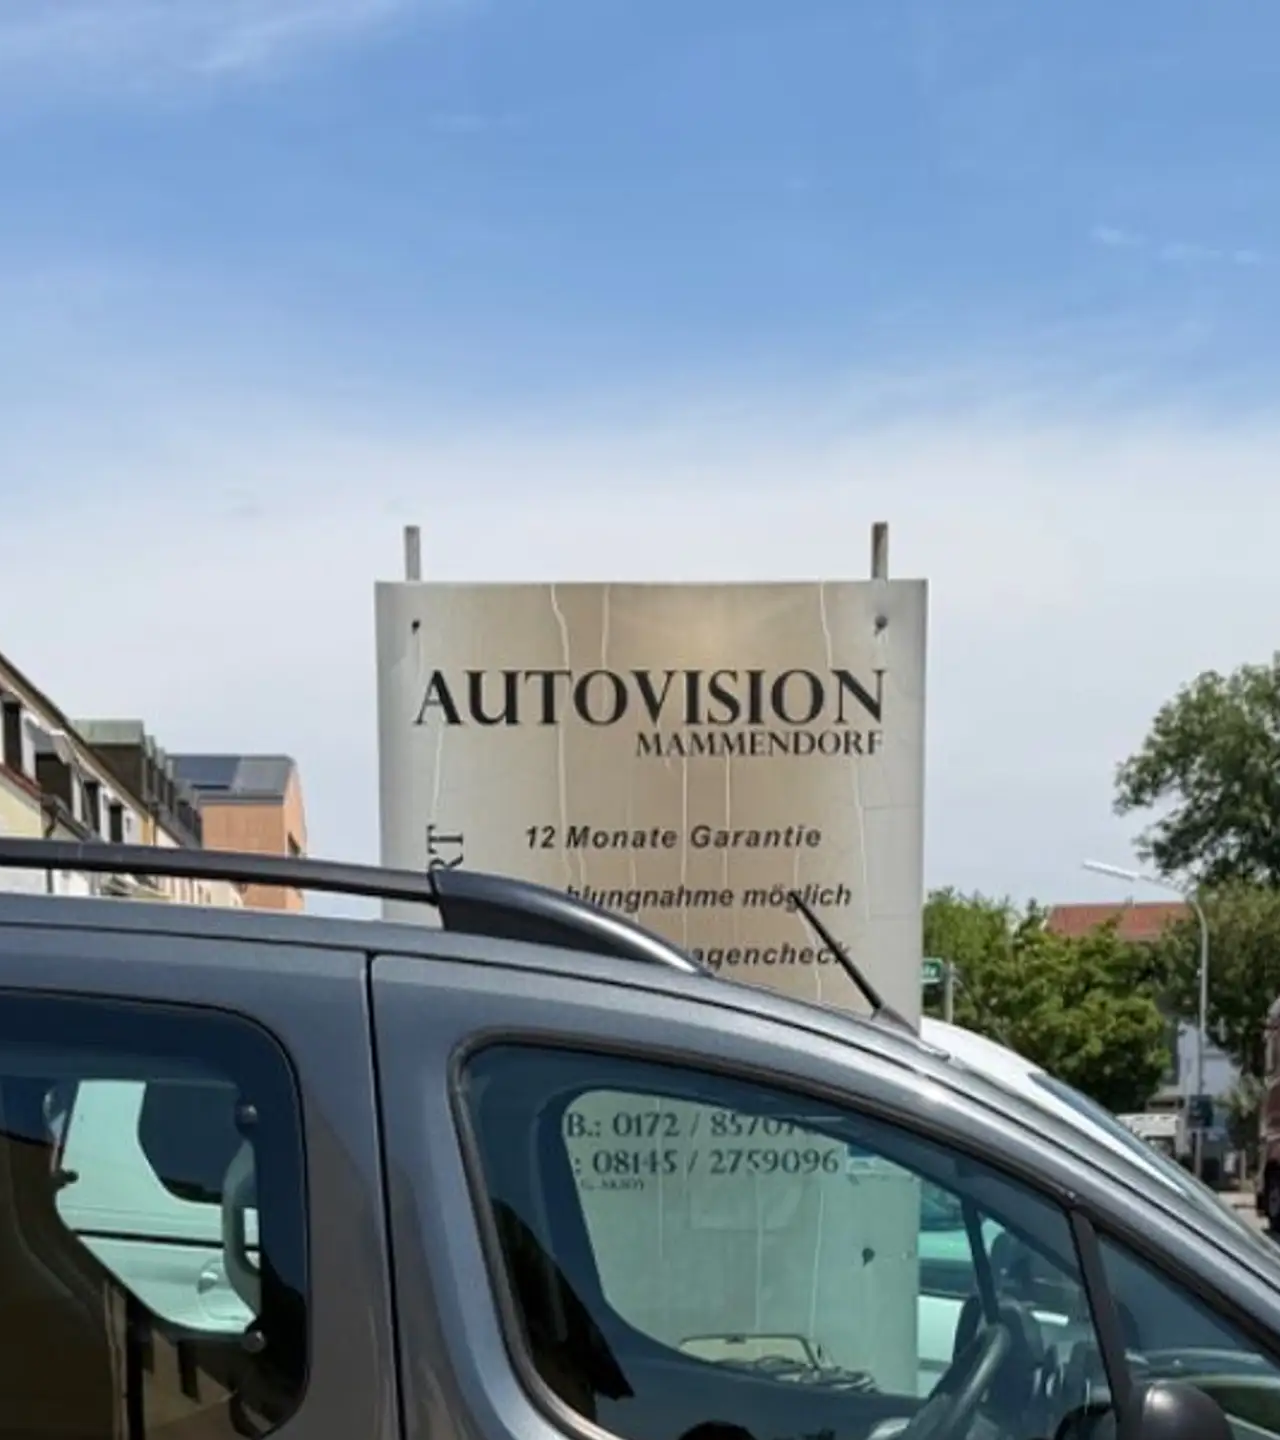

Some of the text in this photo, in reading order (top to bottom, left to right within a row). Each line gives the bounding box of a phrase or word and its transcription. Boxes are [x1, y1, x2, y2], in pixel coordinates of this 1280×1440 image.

[414, 668, 887, 727] AUTOVISION
[636, 731, 883, 758] MAMMENDORF
[526, 825, 822, 850] 12 Monate Garantie
[612, 1111, 680, 1138] 0172
[592, 1150, 677, 1175] 08145
[710, 1150, 839, 1175] 2759096
